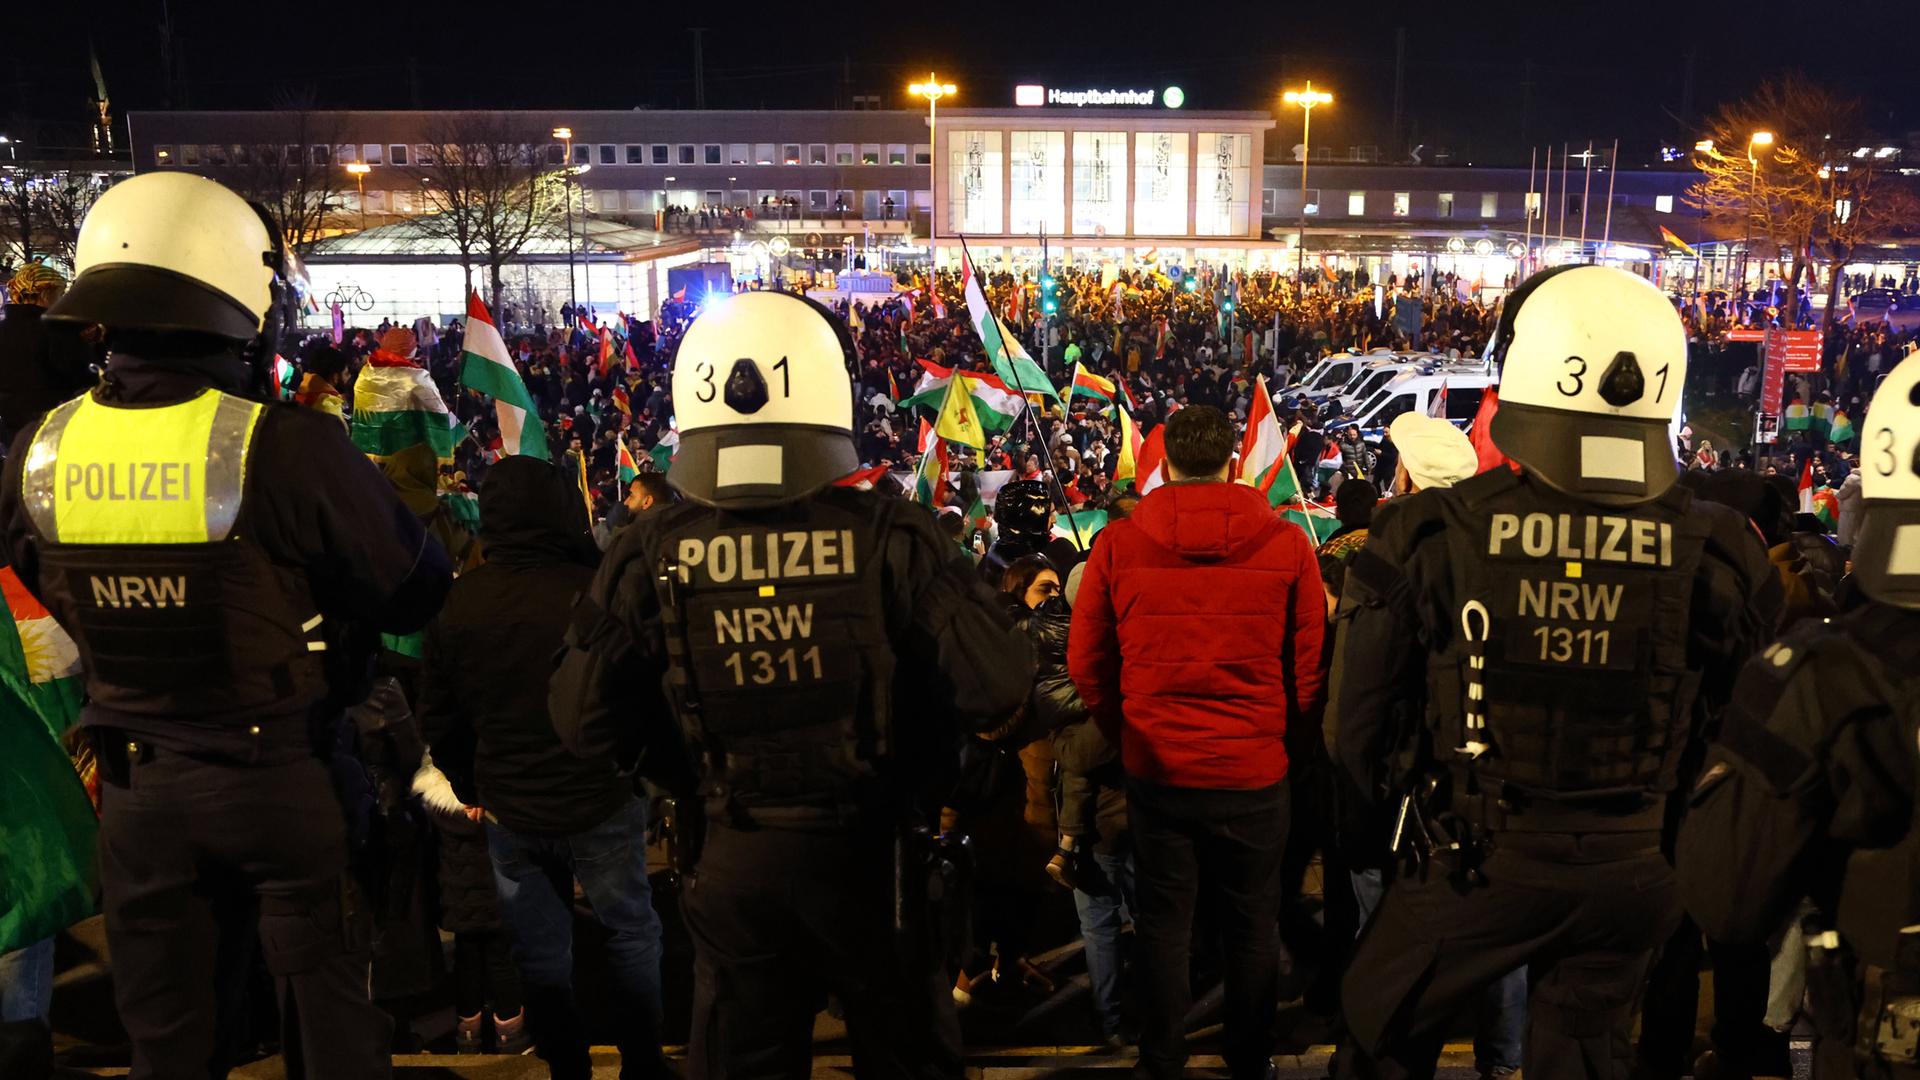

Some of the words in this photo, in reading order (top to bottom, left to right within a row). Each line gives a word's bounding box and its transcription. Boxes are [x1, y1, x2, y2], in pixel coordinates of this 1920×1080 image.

[1048, 89, 1154, 107] Hauptbahnhof
[696, 362, 716, 403] 3
[773, 355, 789, 398] 1
[1557, 356, 1587, 396] 3
[1656, 363, 1669, 404] 1
[1875, 427, 1896, 477] 3
[65, 462, 191, 501] POLIZEI
[678, 529, 855, 584] POLIZEI
[1489, 512, 1672, 567] POLIZEI
[90, 575, 186, 608] NRW
[1518, 579, 1623, 622] NRW
[714, 603, 813, 644] NRW
[725, 645, 823, 686] 1311
[1533, 625, 1610, 665] 1311
